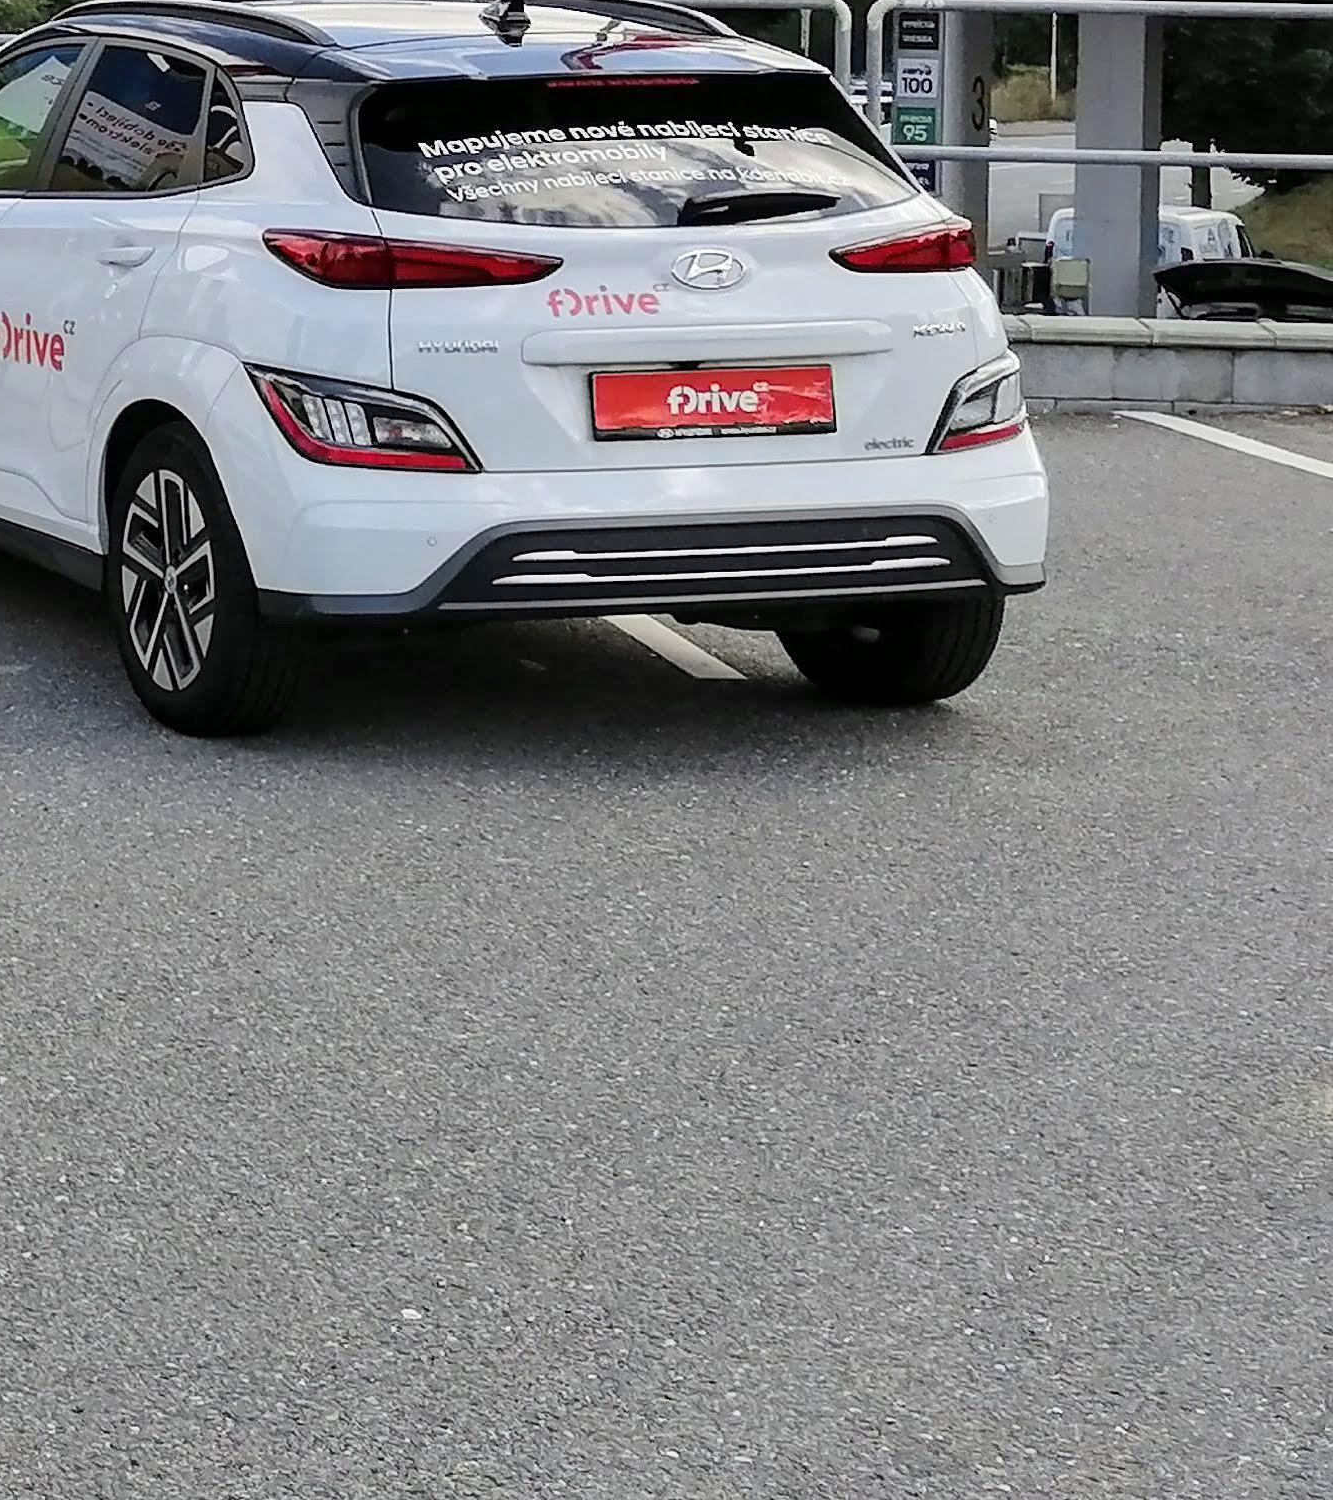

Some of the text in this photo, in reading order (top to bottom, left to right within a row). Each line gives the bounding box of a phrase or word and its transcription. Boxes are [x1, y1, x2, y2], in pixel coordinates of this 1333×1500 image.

[902, 77, 933, 94] 100
[972, 75, 985, 131] 3
[418, 130, 567, 158] Mapujeme
[569, 121, 636, 139] nové
[742, 125, 832, 144] stanice
[903, 125, 928, 142] 95
[434, 143, 667, 186] pro elektromobily
[446, 177, 539, 203] Všechny
[630, 167, 706, 182] stanice
[708, 169, 736, 181] na
